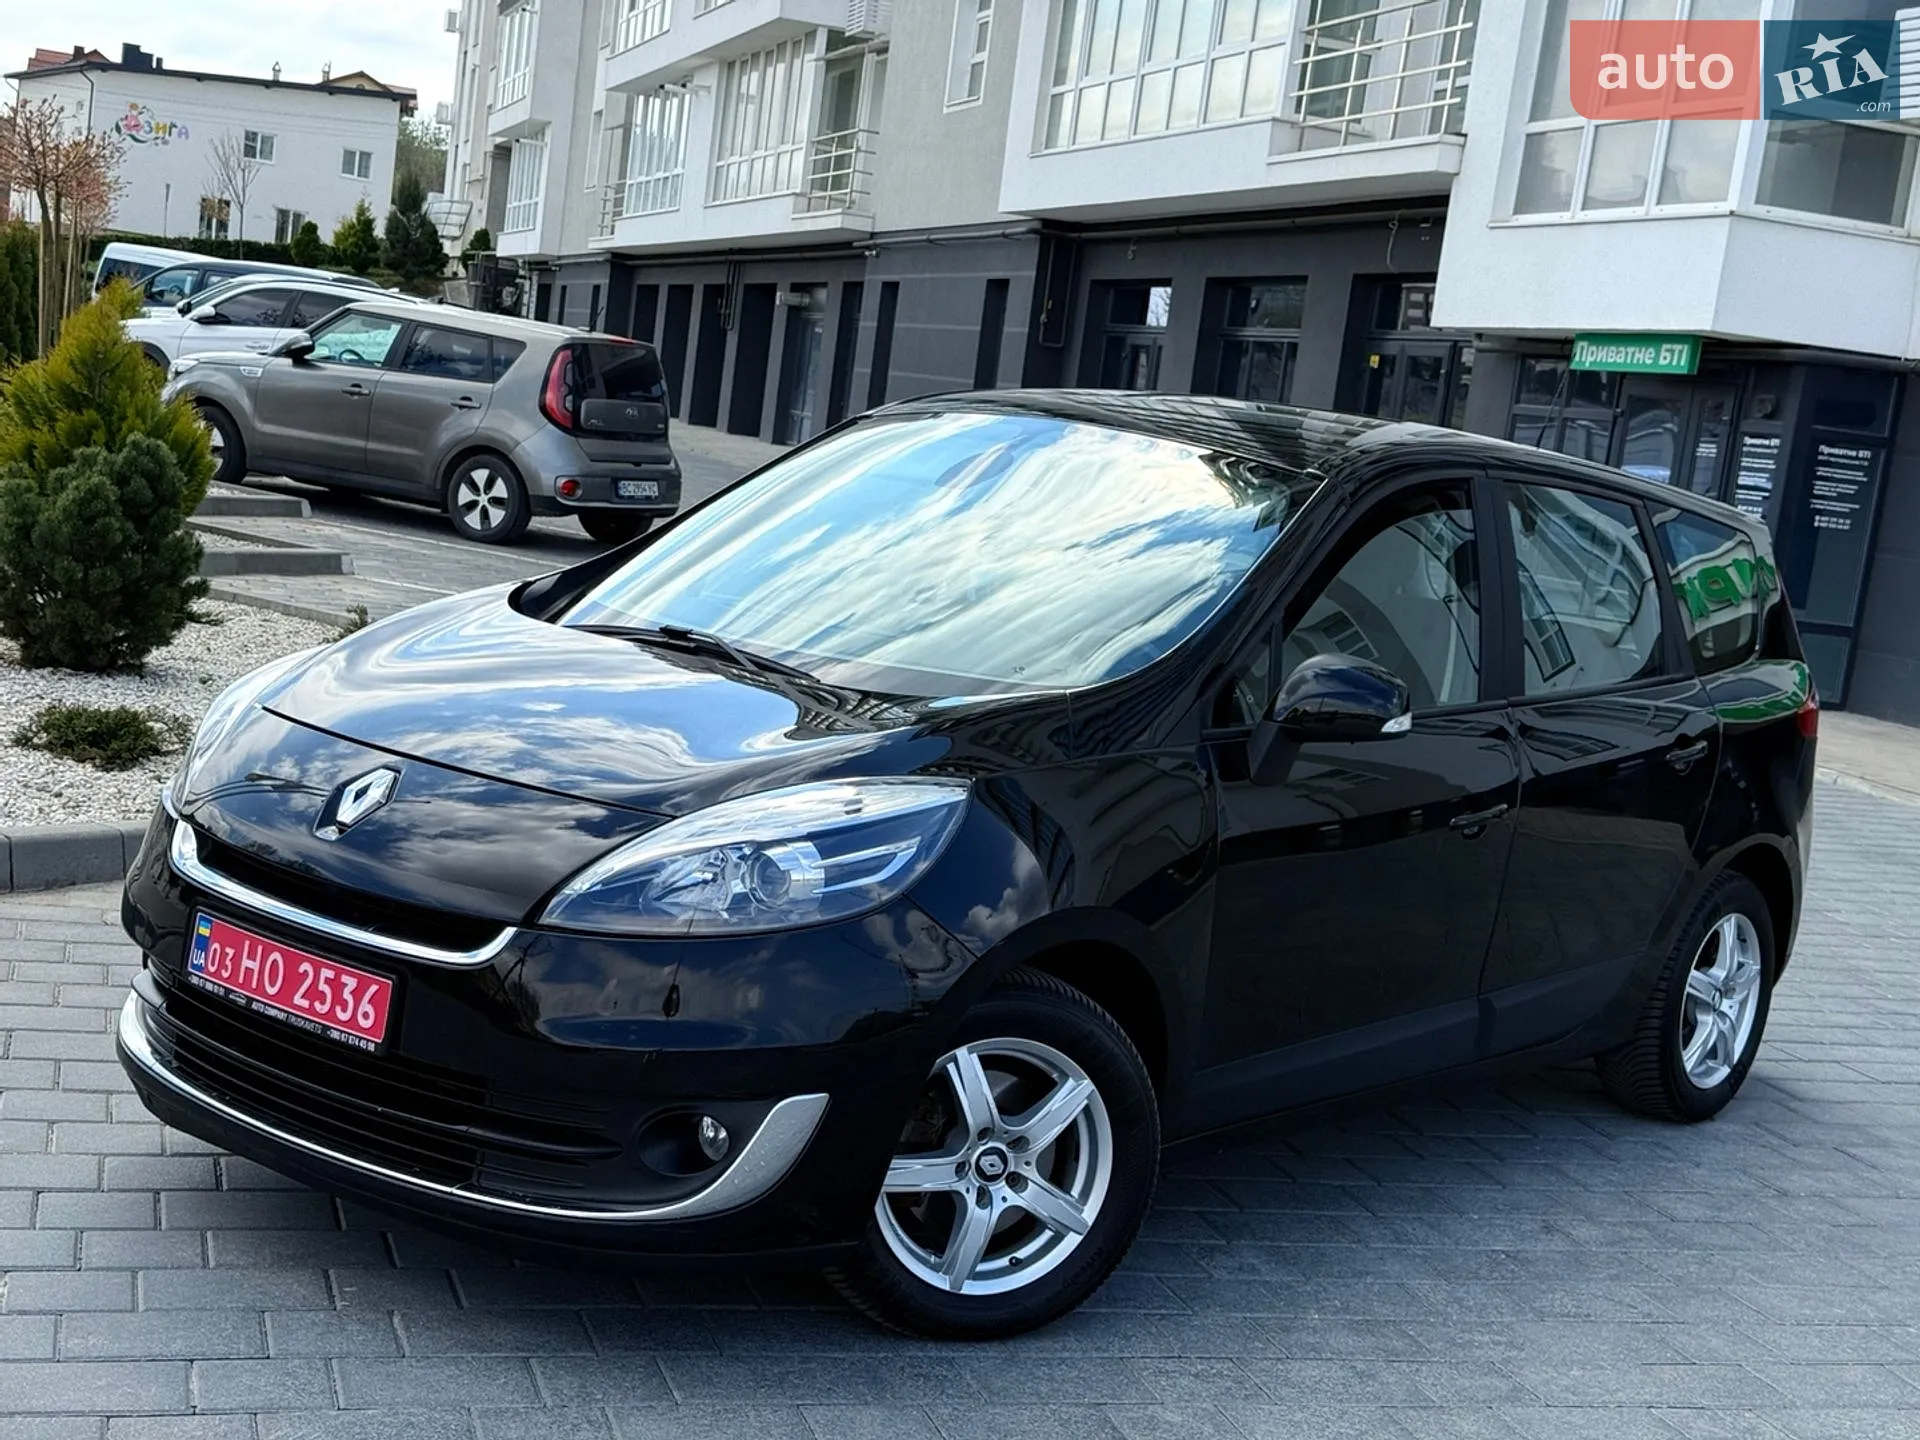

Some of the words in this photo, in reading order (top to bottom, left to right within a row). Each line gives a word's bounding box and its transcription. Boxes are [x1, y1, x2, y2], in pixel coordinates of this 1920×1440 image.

[1574, 340, 1656, 368] Приватне
[1659, 343, 1690, 367] БТІ
[193, 949, 206, 968] UA
[207, 942, 236, 979] 03
[292, 961, 381, 1029] 2536
